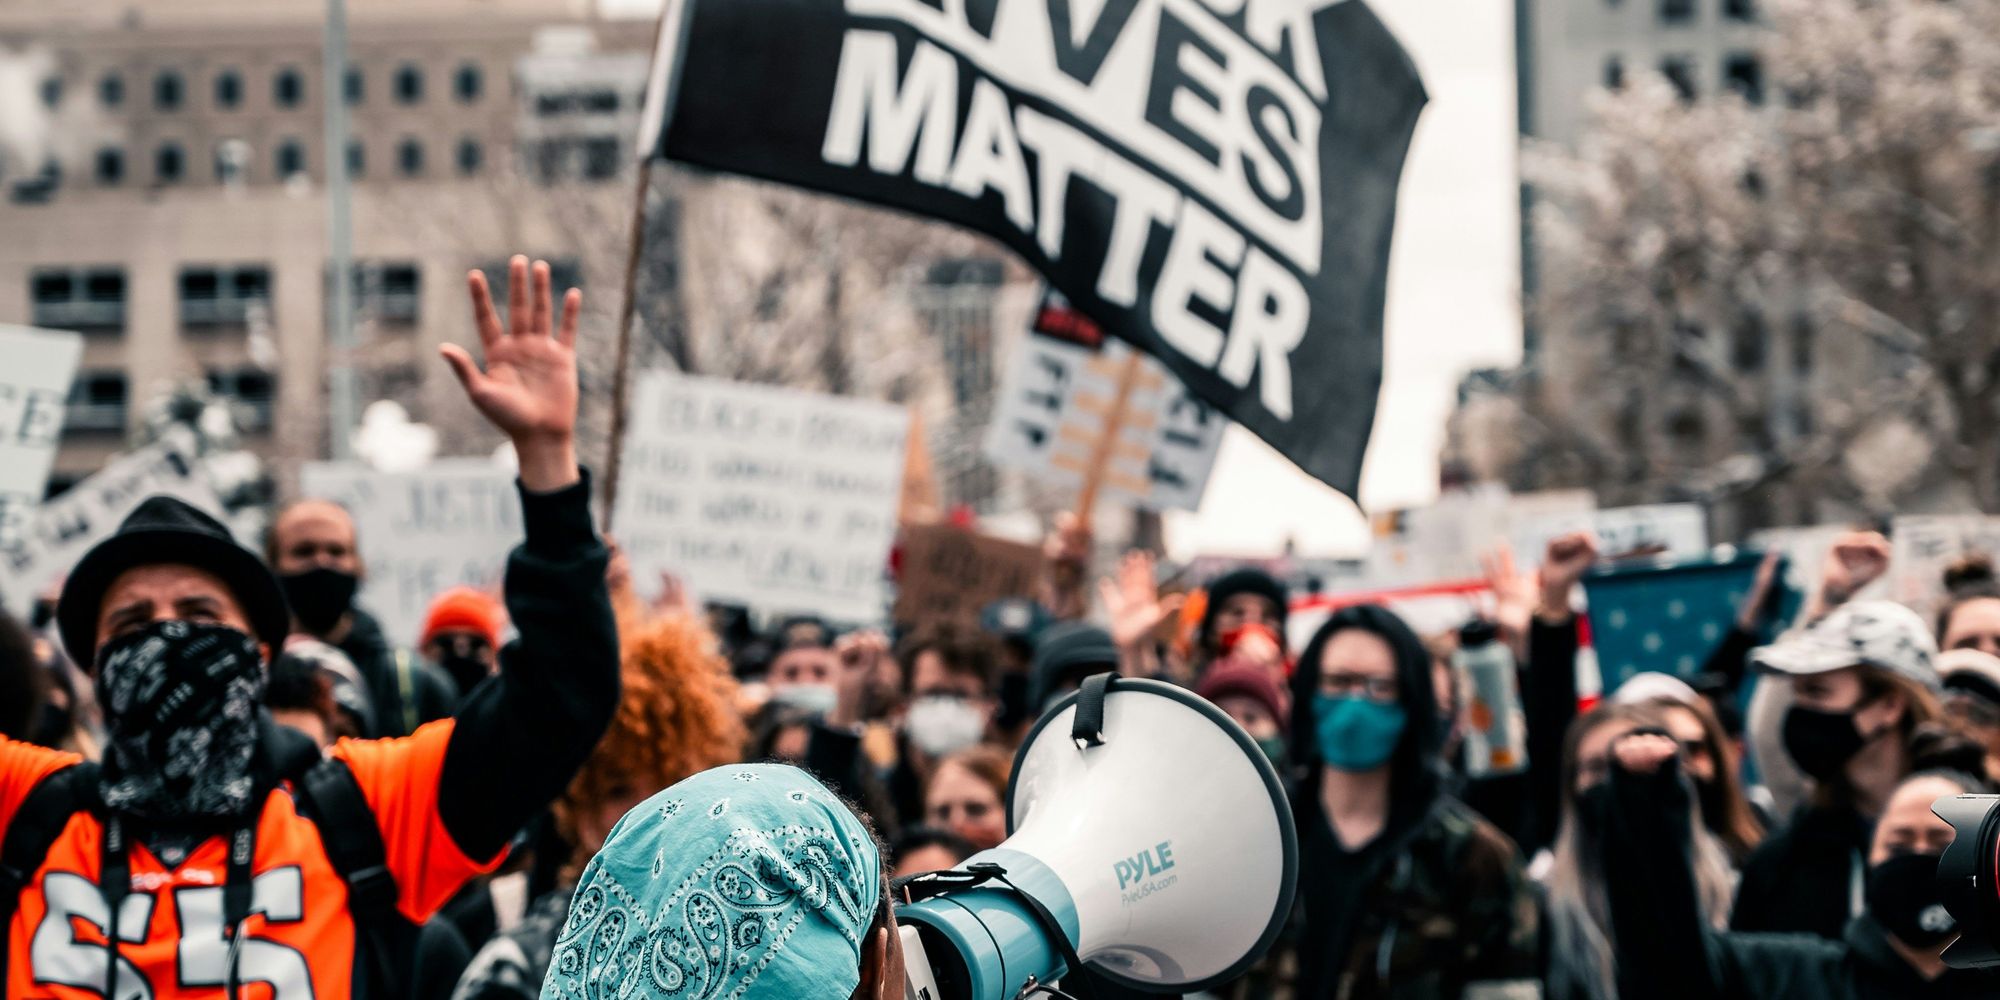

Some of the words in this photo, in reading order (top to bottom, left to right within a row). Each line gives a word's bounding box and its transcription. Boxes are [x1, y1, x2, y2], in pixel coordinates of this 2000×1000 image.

[822, 29, 1310, 421] MATTER
[30, 864, 316, 1000] 55
[1113, 841, 1175, 890] PYLE
